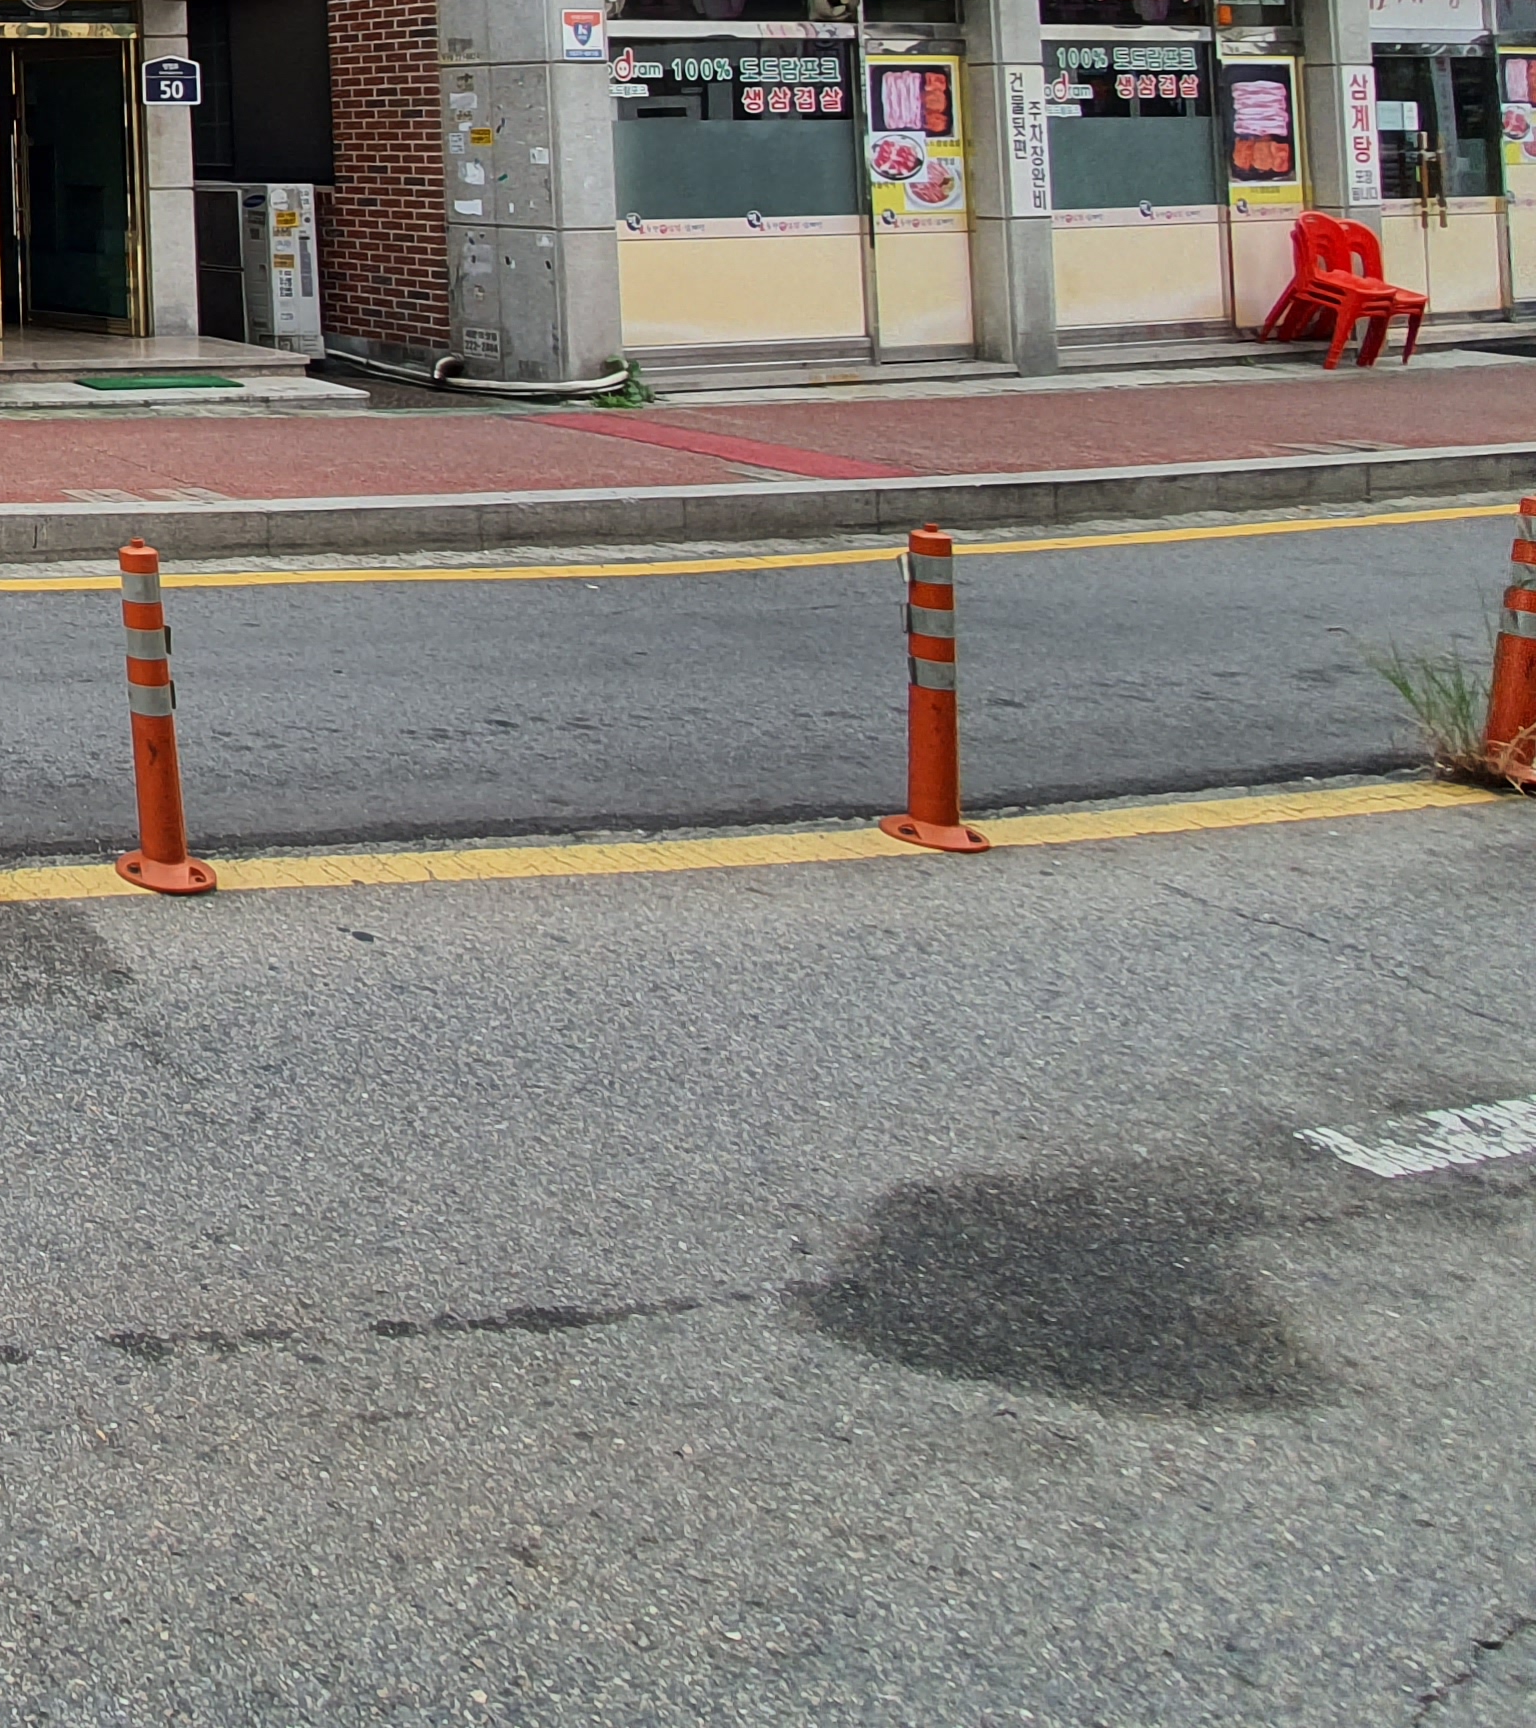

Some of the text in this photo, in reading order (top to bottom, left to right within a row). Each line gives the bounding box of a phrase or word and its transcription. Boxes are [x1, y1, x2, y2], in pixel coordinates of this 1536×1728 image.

[671, 58, 733, 82] 100%
[739, 56, 842, 83] 도드람포크
[1055, 46, 1109, 70] 100%
[159, 80, 184, 100] 50
[1114, 73, 1200, 99] 생삼겹살
[741, 86, 844, 113] 생삼겹살
[1349, 73, 1373, 164] 삼계탕
